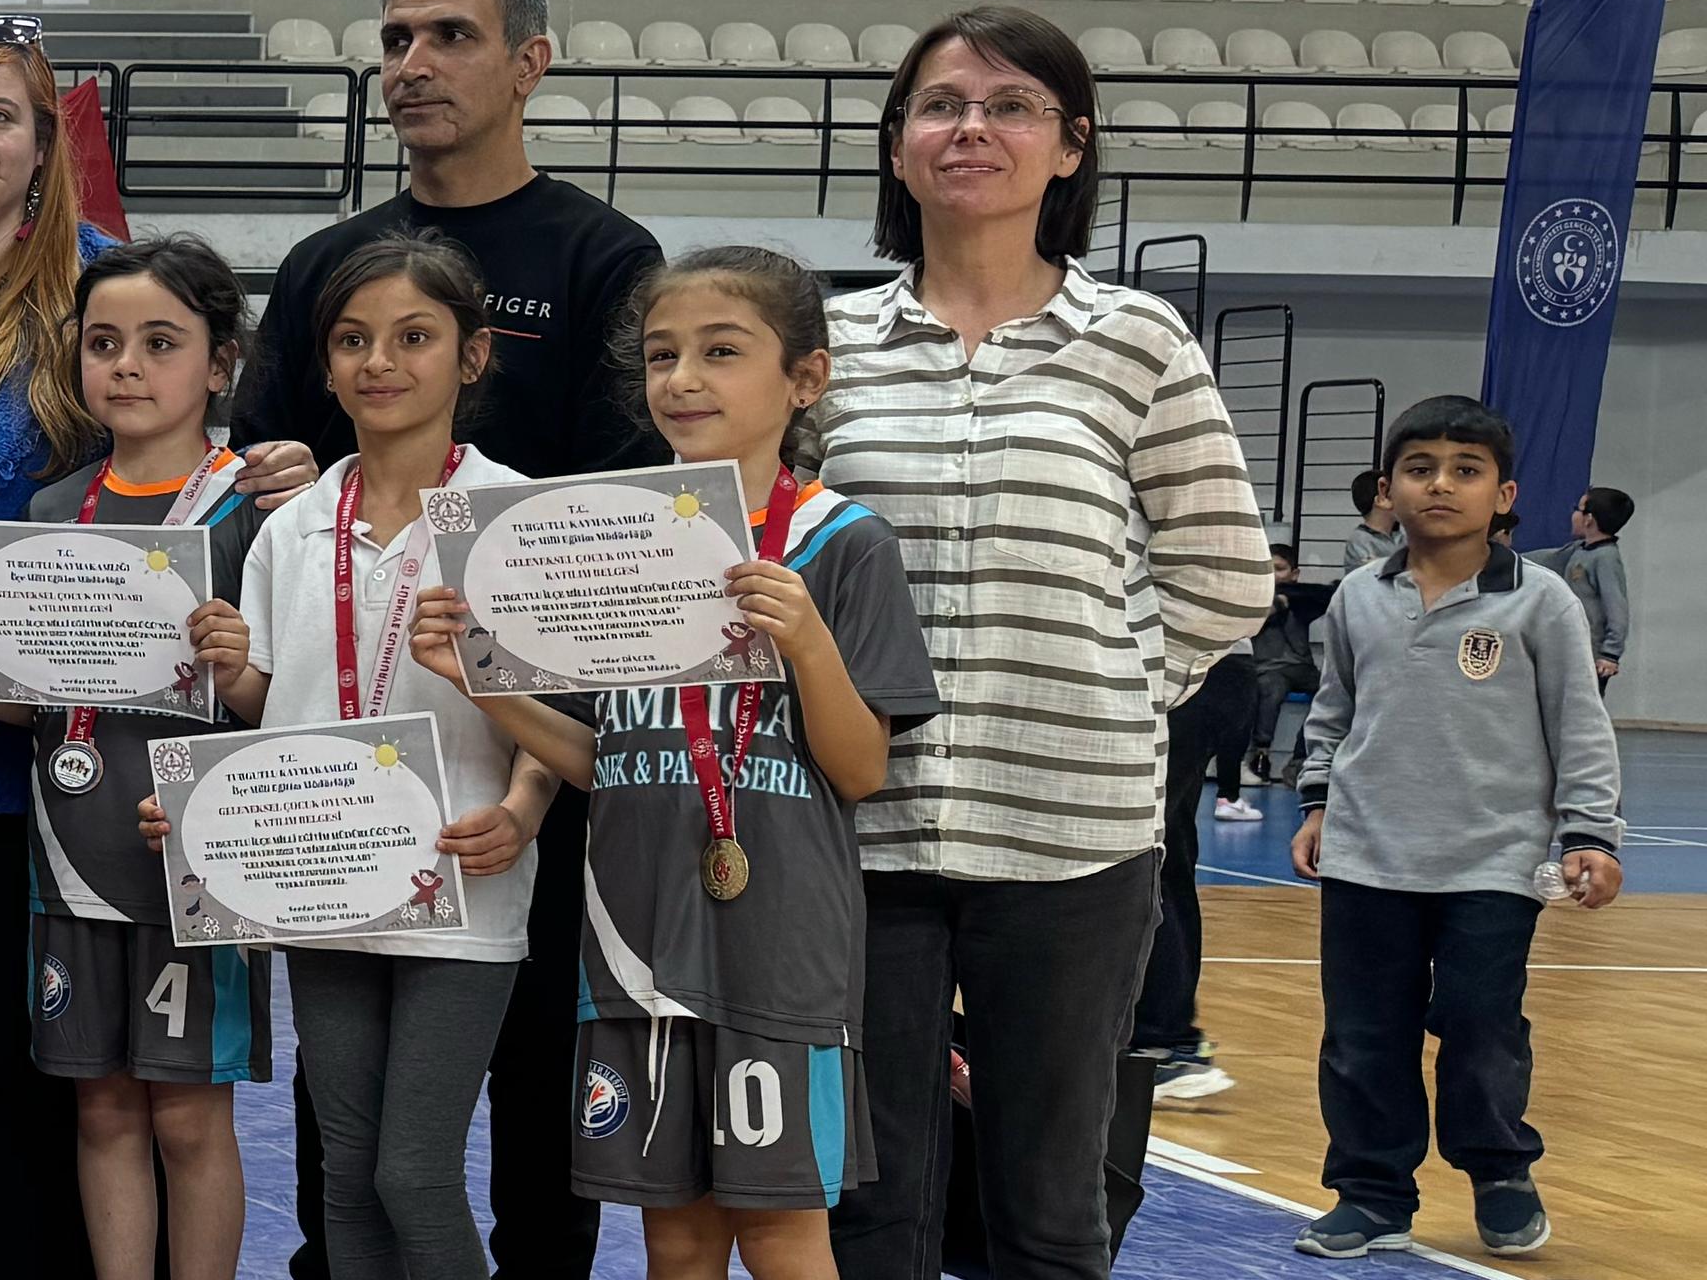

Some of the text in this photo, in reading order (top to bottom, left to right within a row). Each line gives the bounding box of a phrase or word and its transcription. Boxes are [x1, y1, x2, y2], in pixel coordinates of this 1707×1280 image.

[482, 293, 553, 320] FIGER
[634, 750, 652, 785] &
[145, 962, 188, 1038] 4
[713, 1058, 784, 1148] 10
